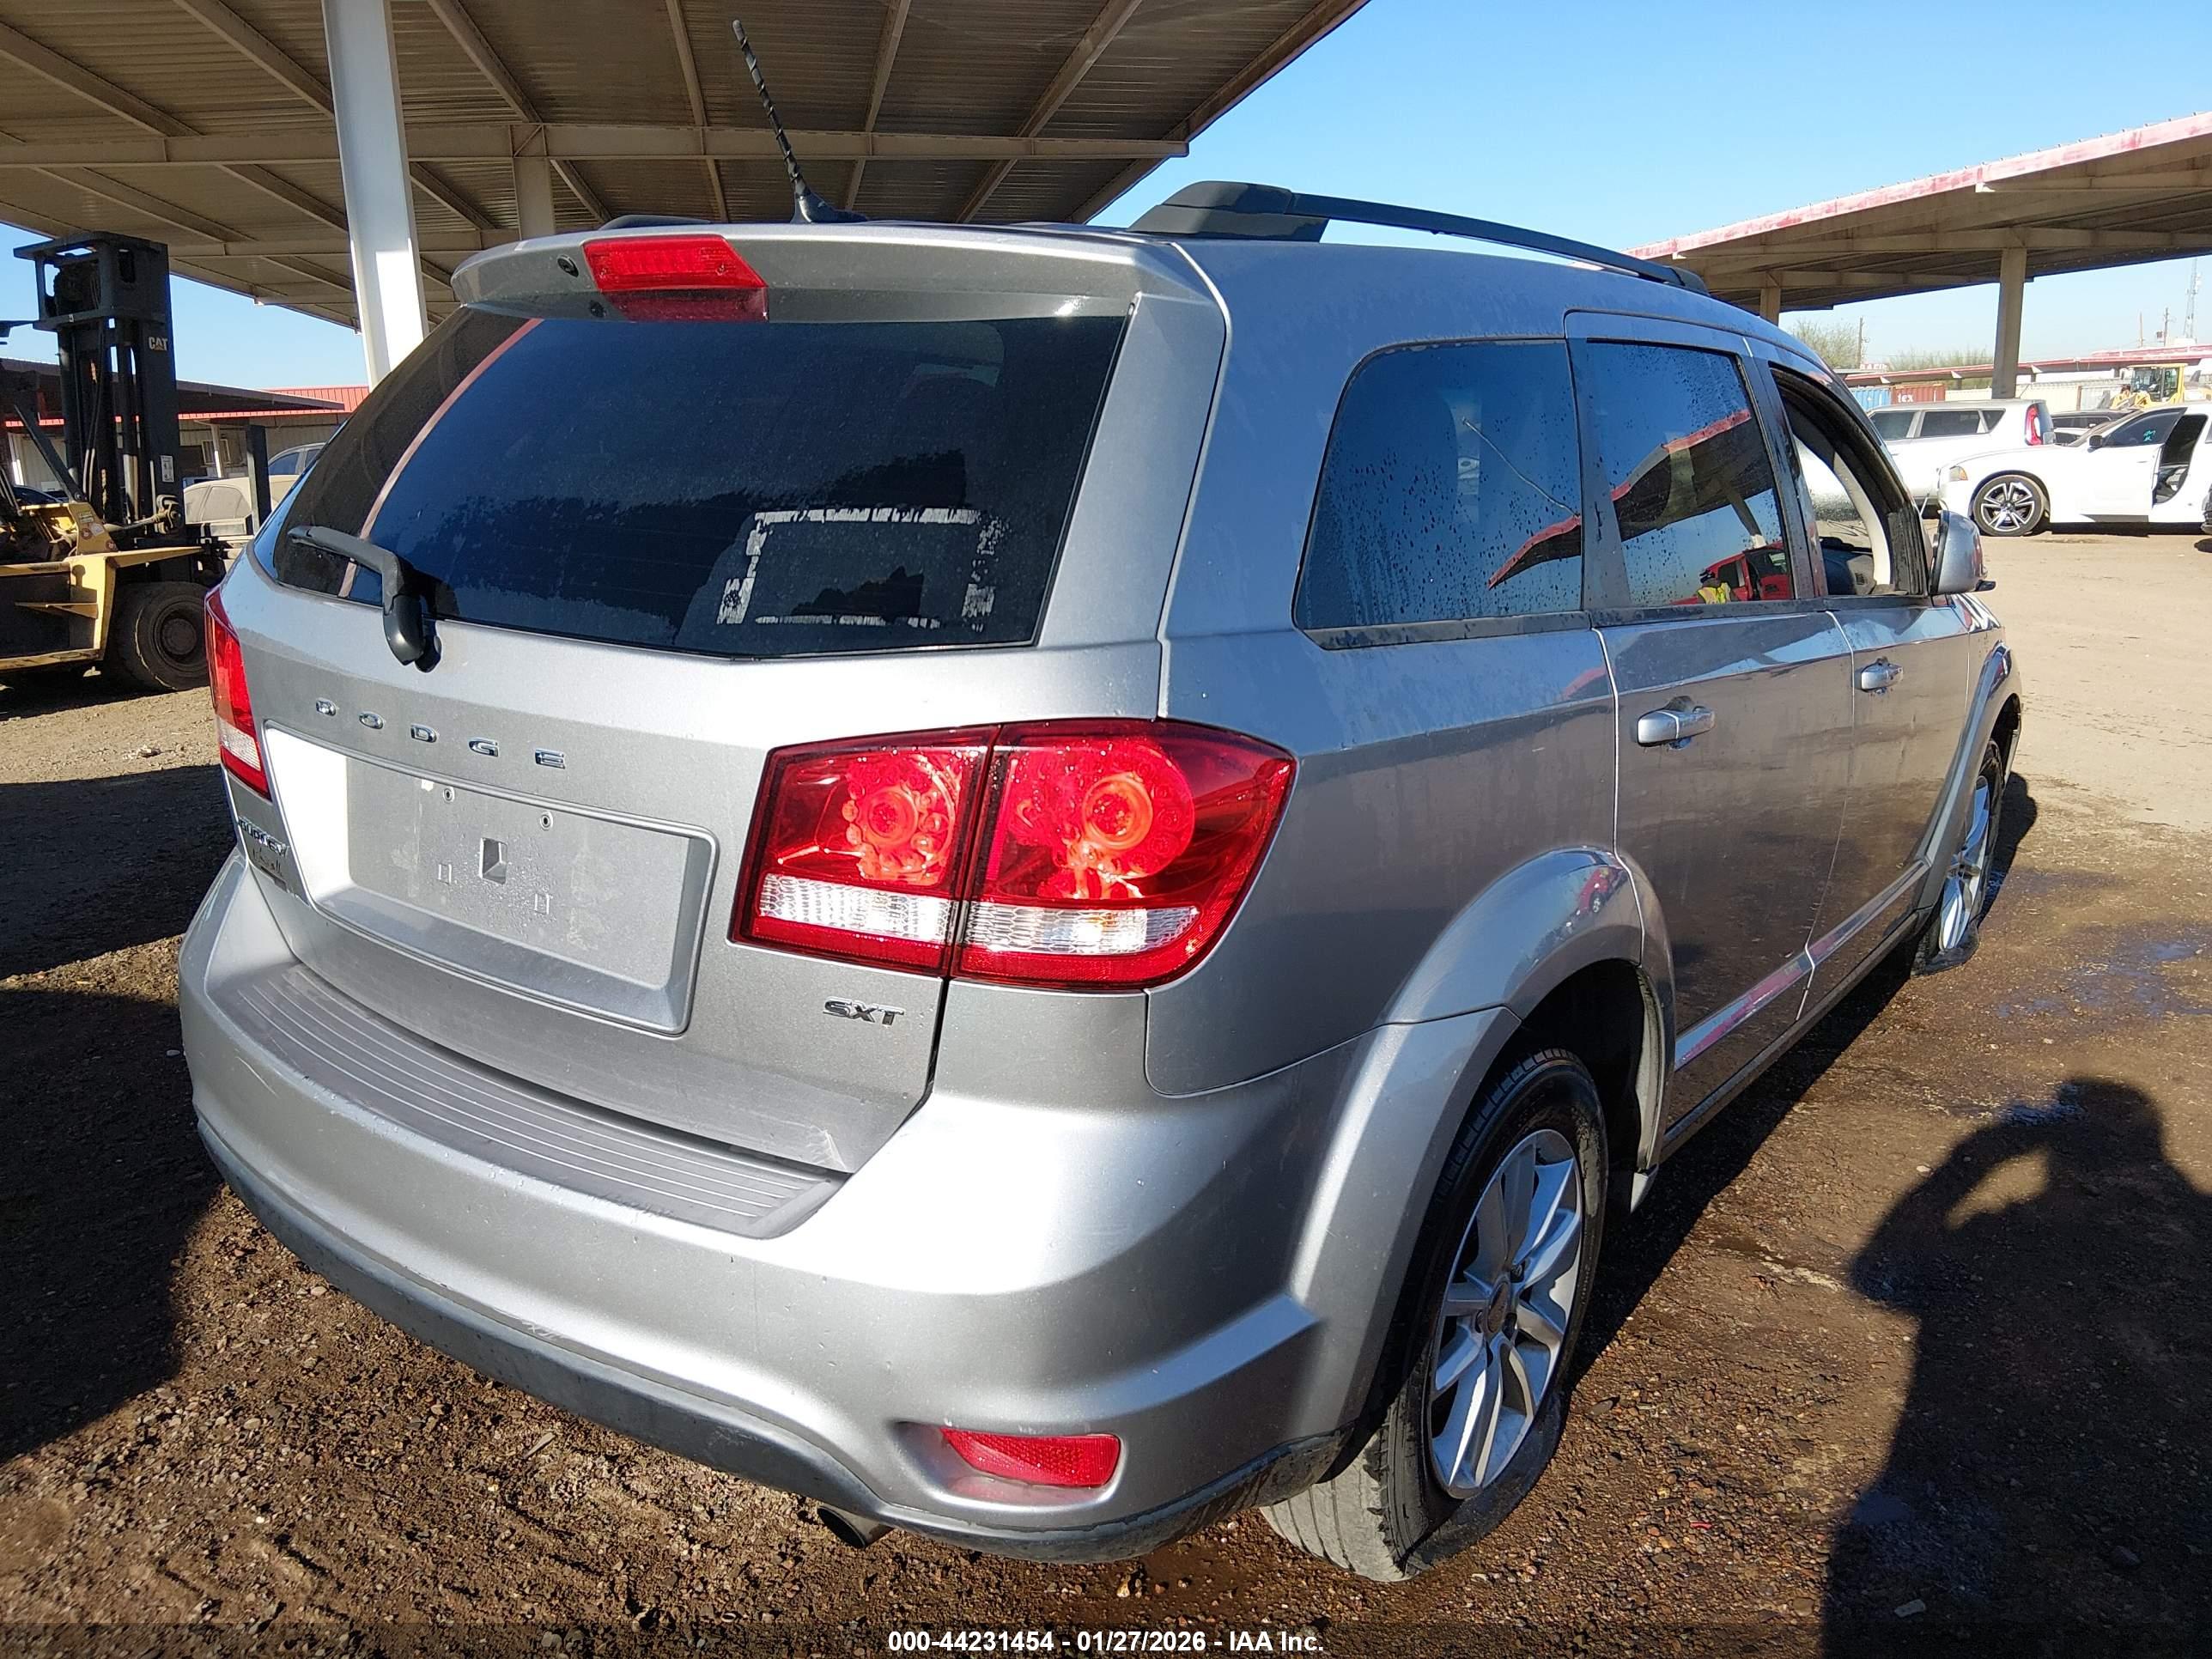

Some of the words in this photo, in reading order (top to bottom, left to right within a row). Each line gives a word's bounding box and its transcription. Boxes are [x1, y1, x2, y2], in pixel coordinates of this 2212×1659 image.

[148, 336, 168, 351] CAT
[315, 696, 566, 770] DODGE
[823, 995, 906, 1028] SXT
